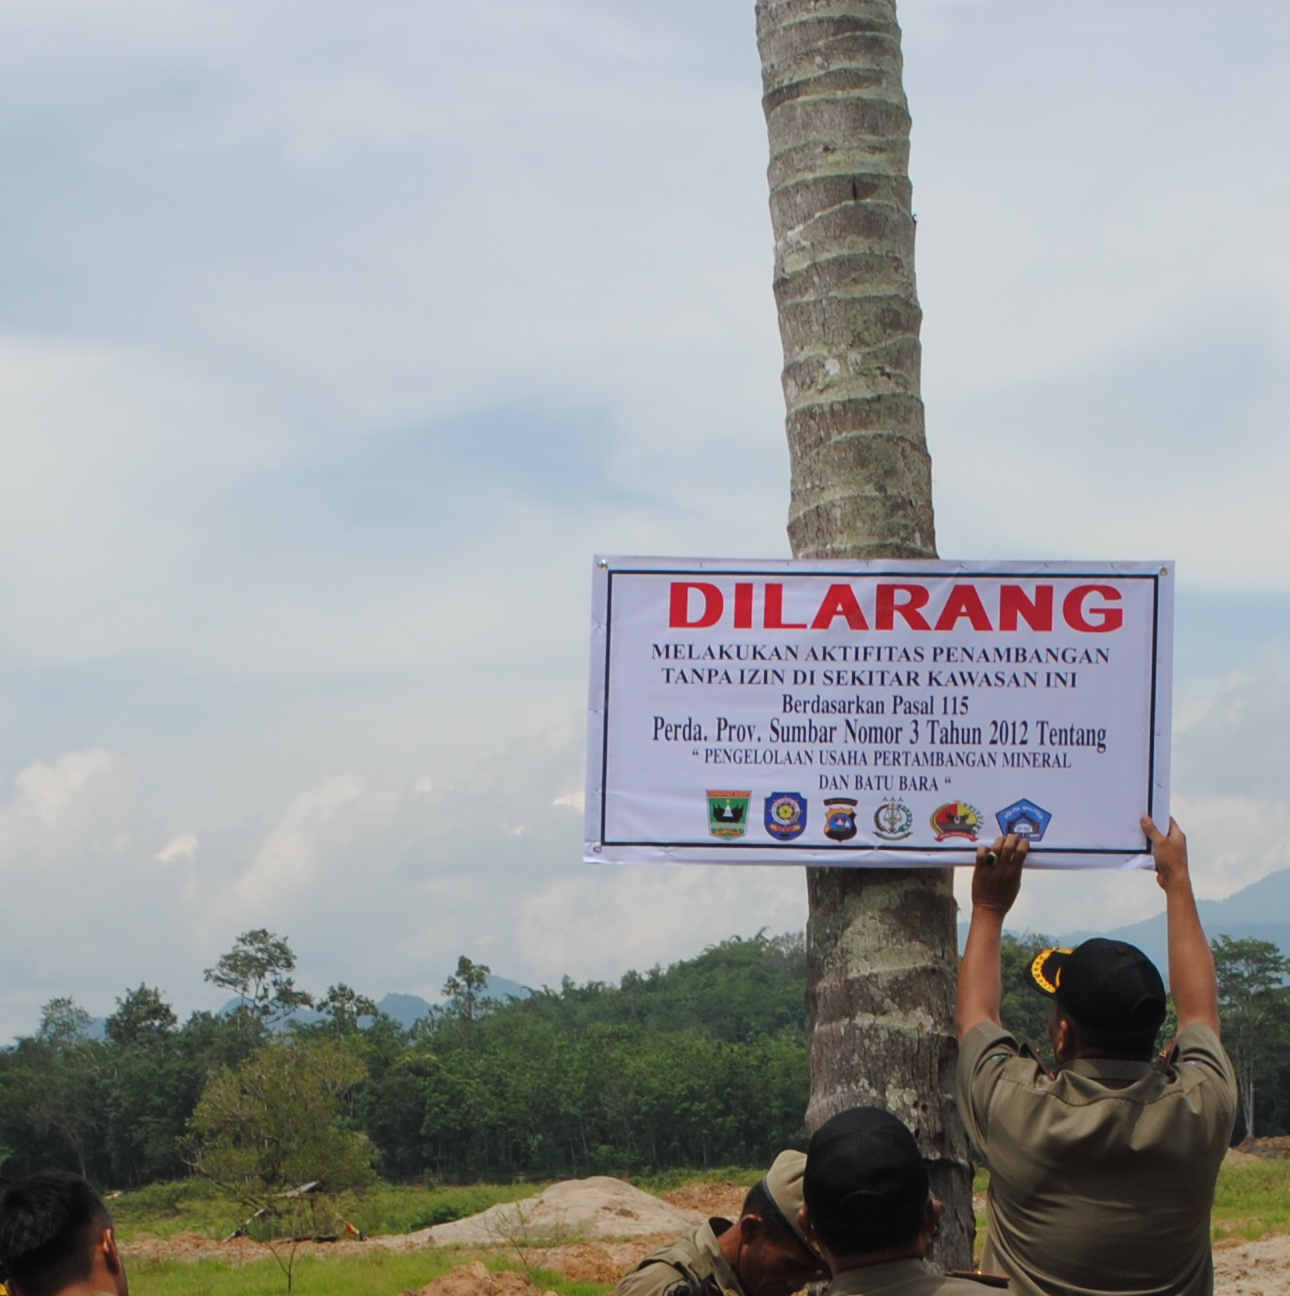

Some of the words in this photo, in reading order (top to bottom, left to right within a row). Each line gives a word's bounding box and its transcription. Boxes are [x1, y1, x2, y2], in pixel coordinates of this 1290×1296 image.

[669, 582, 1123, 633] DILARANG
[651, 643, 799, 661] MELAKUKAN
[805, 645, 925, 663] AKTIFITAS
[932, 646, 1111, 664] PENAMBANGAN
[661, 667, 732, 685] TANPA
[739, 668, 785, 686] IZIN
[793, 669, 816, 686] DI
[822, 669, 921, 687] SEKITAR
[927, 671, 1038, 688] KAWASAN
[1045, 671, 1078, 689] INI
[782, 694, 885, 715] Berdasarkan
[892, 695, 934, 715] Pasal
[942, 696, 969, 715] 115
[652, 716, 708, 742] Perda.
[716, 717, 761, 743] Prov.
[769, 718, 837, 743] Sumbar
[844, 718, 903, 744] Nomor
[909, 719, 920, 745] 3
[926, 720, 982, 745] Tahun
[989, 720, 1029, 746] 2012
[1036, 720, 1107, 754] Tentang
[704, 748, 814, 765] PENGELOLAAN
[819, 750, 868, 766] USAHA
[873, 751, 998, 768] PERTAMBANGAN
[1002, 752, 1072, 769] MINERAL
[818, 774, 849, 790] DAN
[854, 775, 894, 791] BATU
[899, 775, 939, 792] BARA
